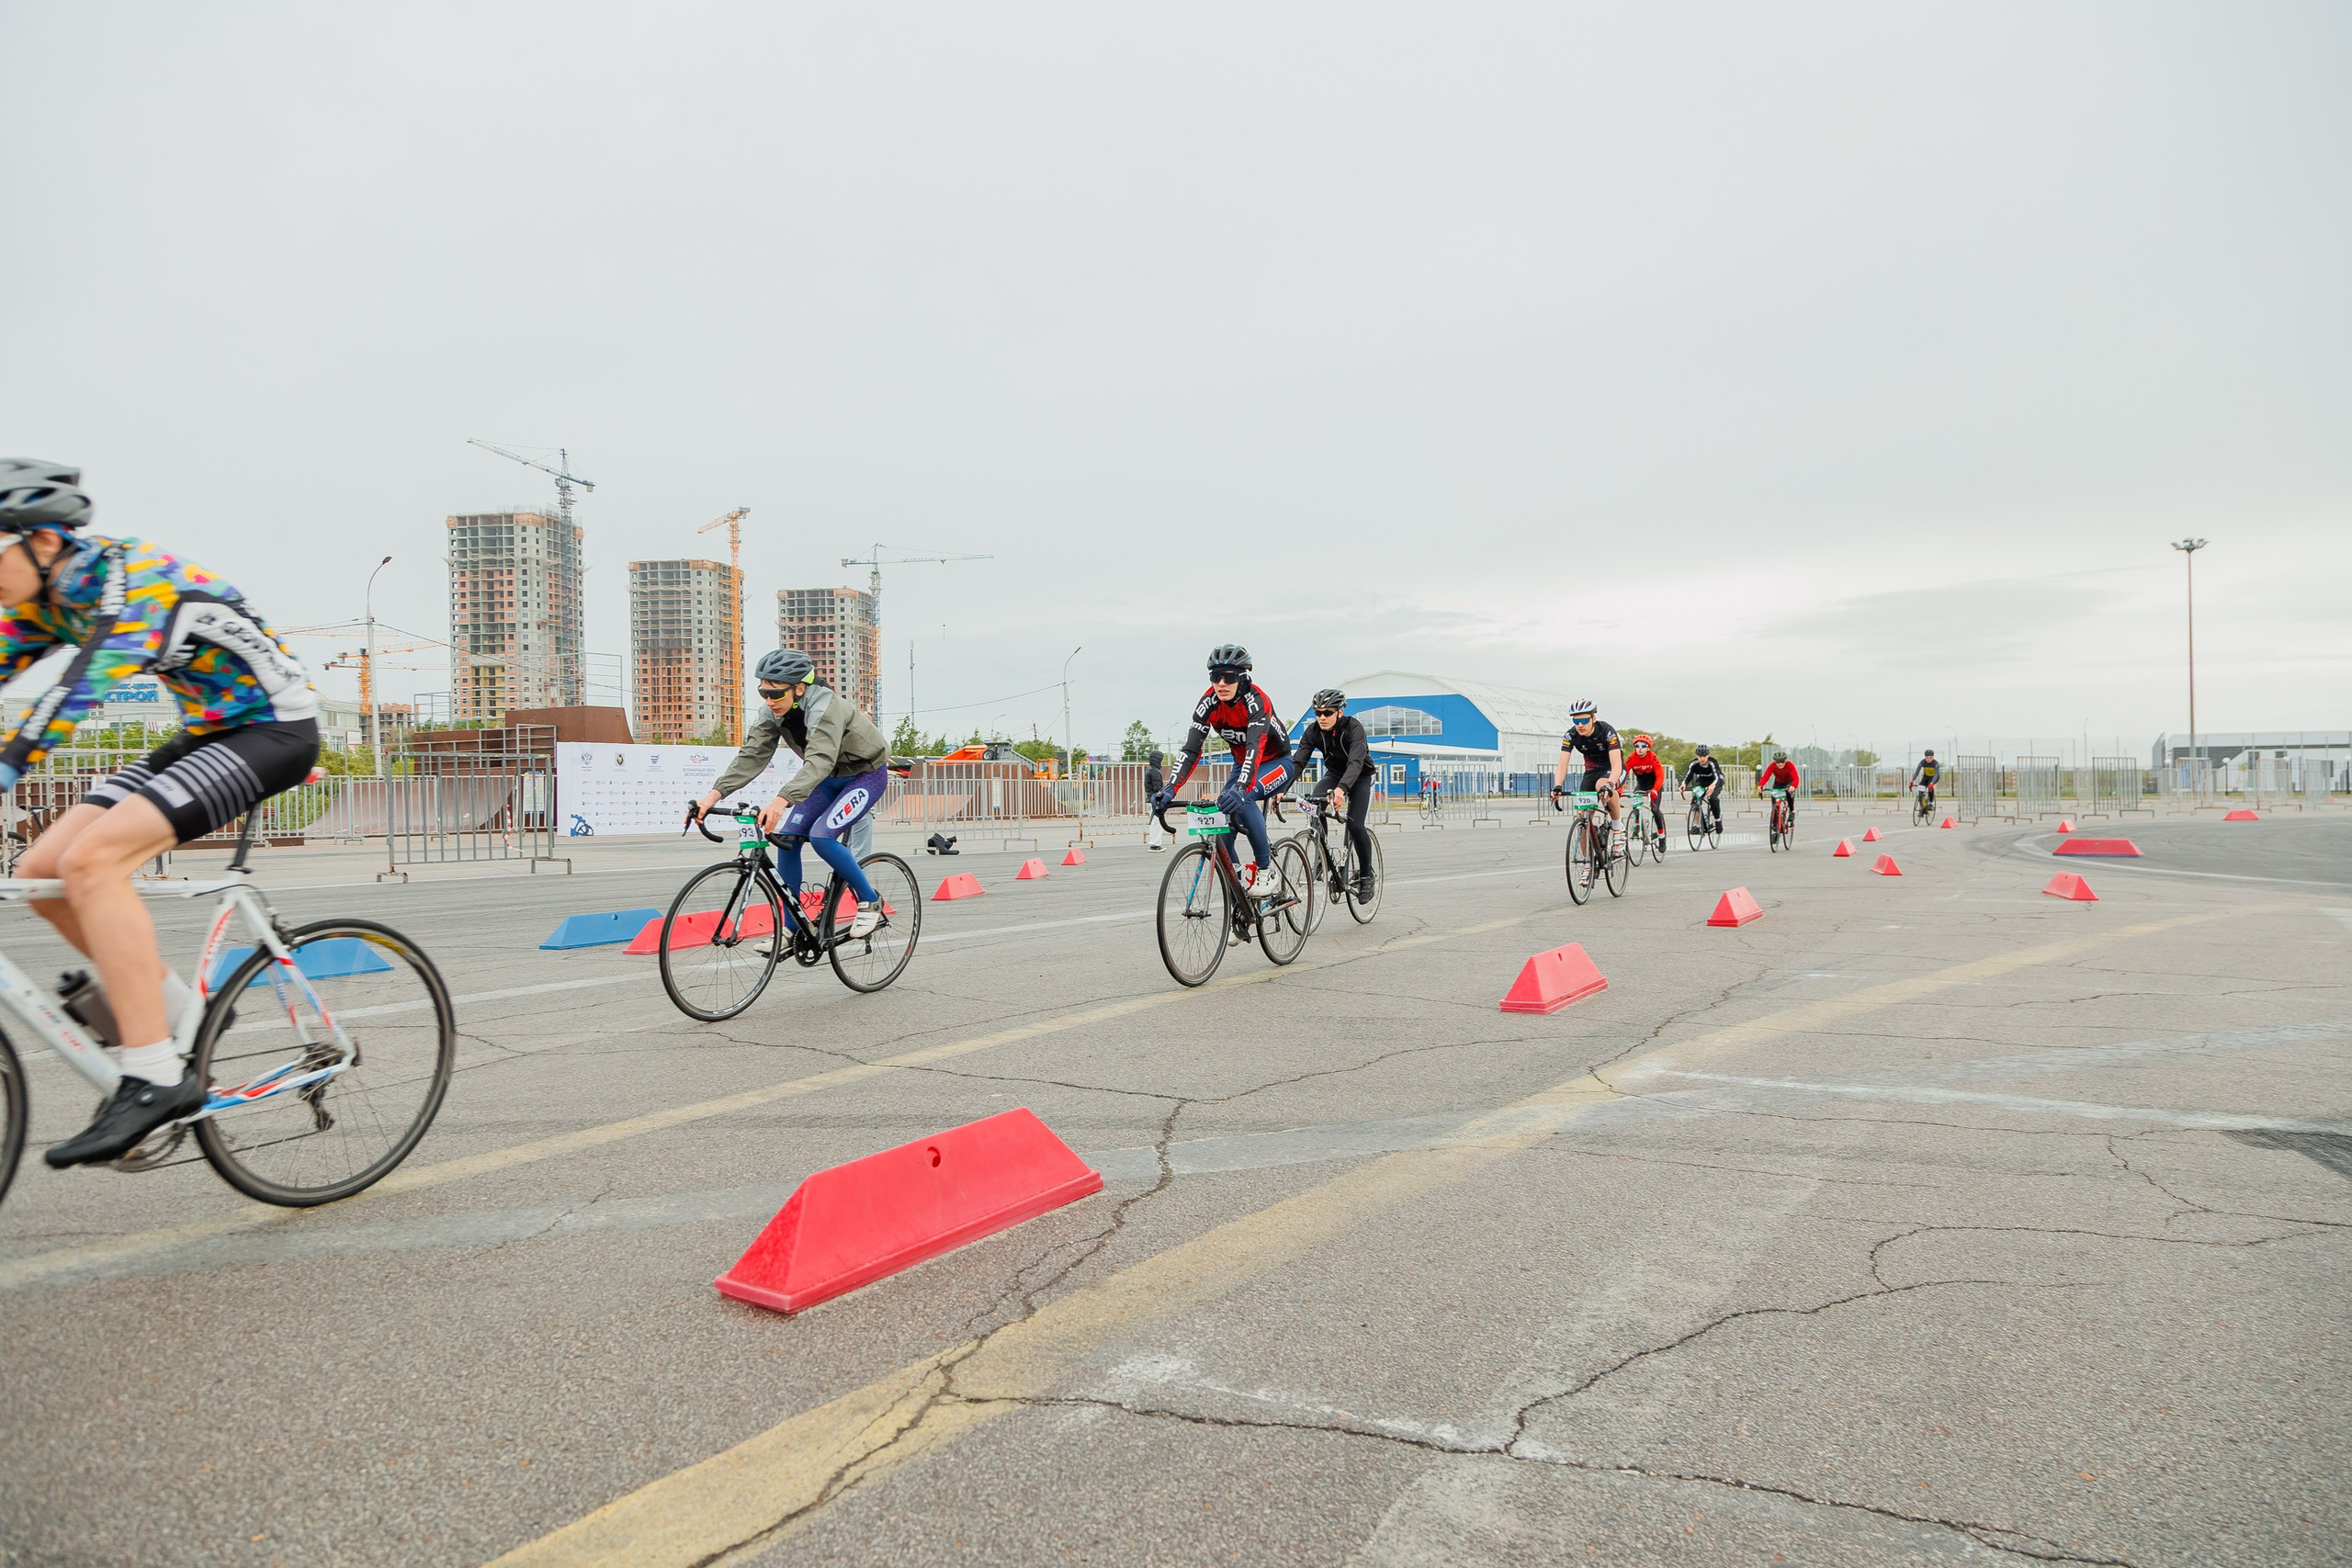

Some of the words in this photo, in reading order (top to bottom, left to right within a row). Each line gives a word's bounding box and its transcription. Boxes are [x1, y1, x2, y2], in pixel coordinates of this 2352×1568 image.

[1220, 728, 1247, 742] BM
[1237, 749, 1255, 784] BMC
[832, 790, 865, 826] ITERA
[1197, 817, 1215, 826] 927
